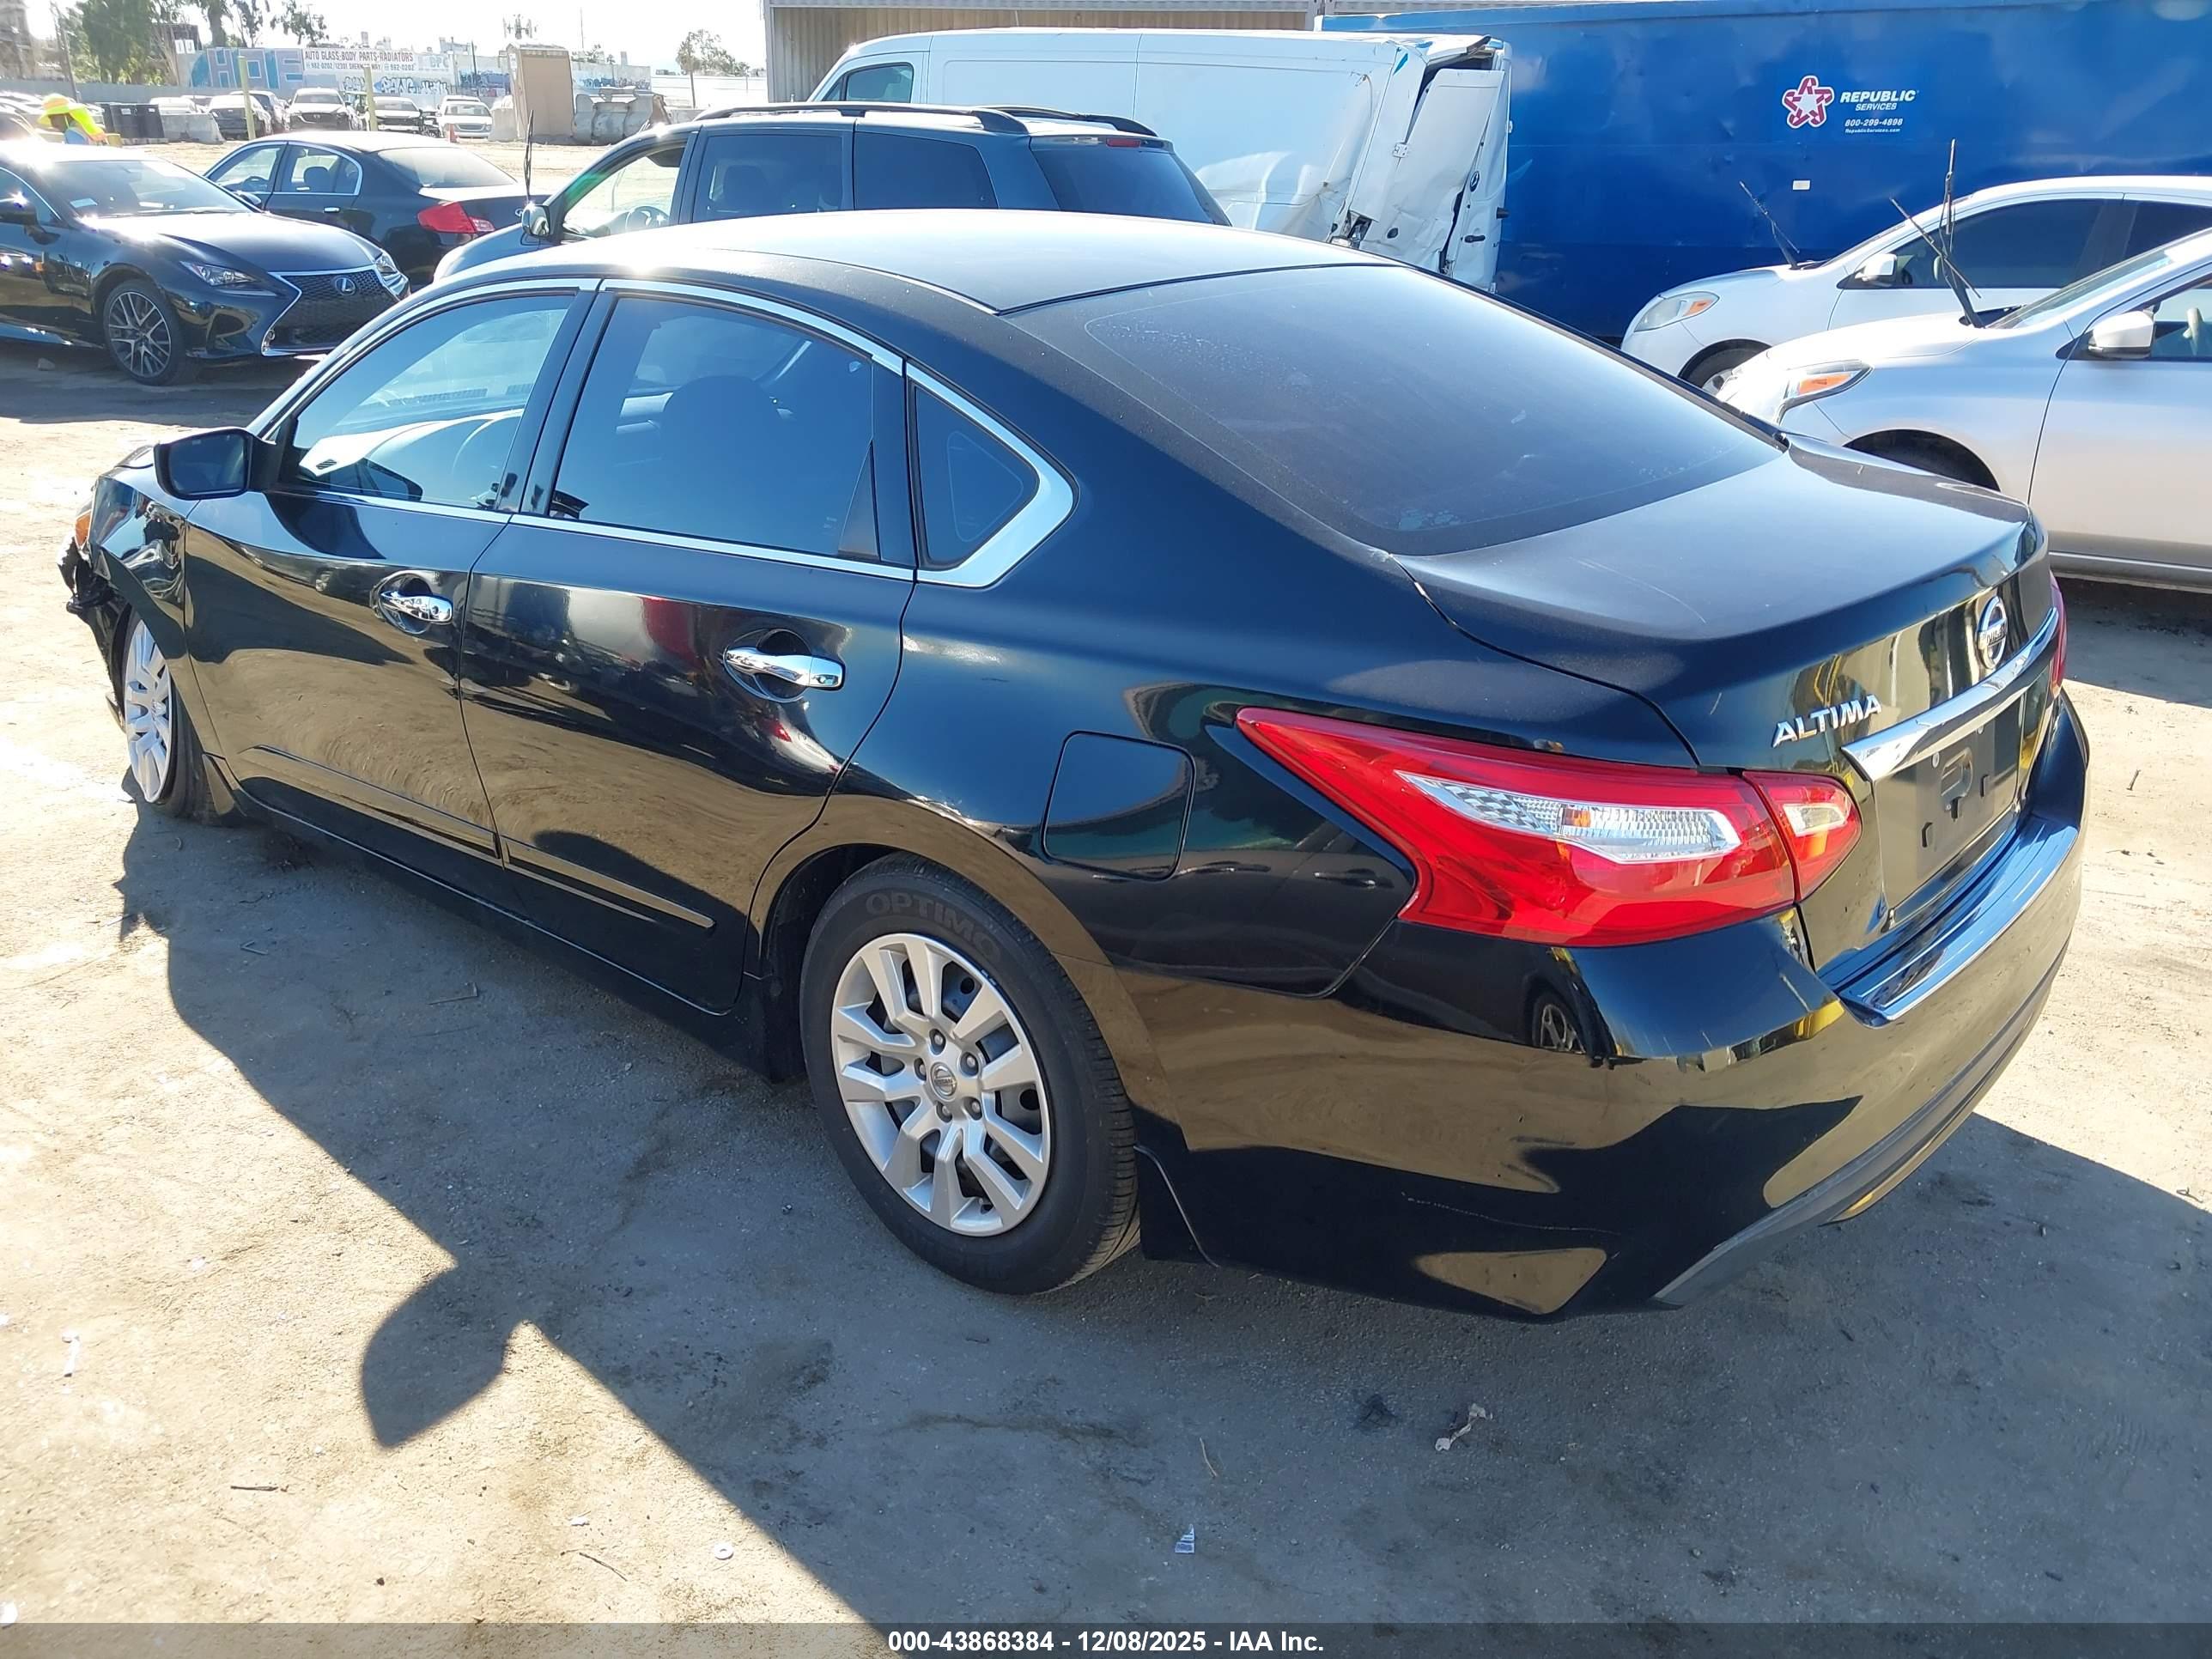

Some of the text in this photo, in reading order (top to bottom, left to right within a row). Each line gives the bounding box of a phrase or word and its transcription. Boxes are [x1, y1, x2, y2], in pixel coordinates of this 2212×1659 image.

[305, 51, 319, 60] AUTO
[1840, 90, 1916, 102] REPUBLIC
[1771, 694, 1882, 749] ALTIMA
[866, 892, 1001, 963] OPTIMO
